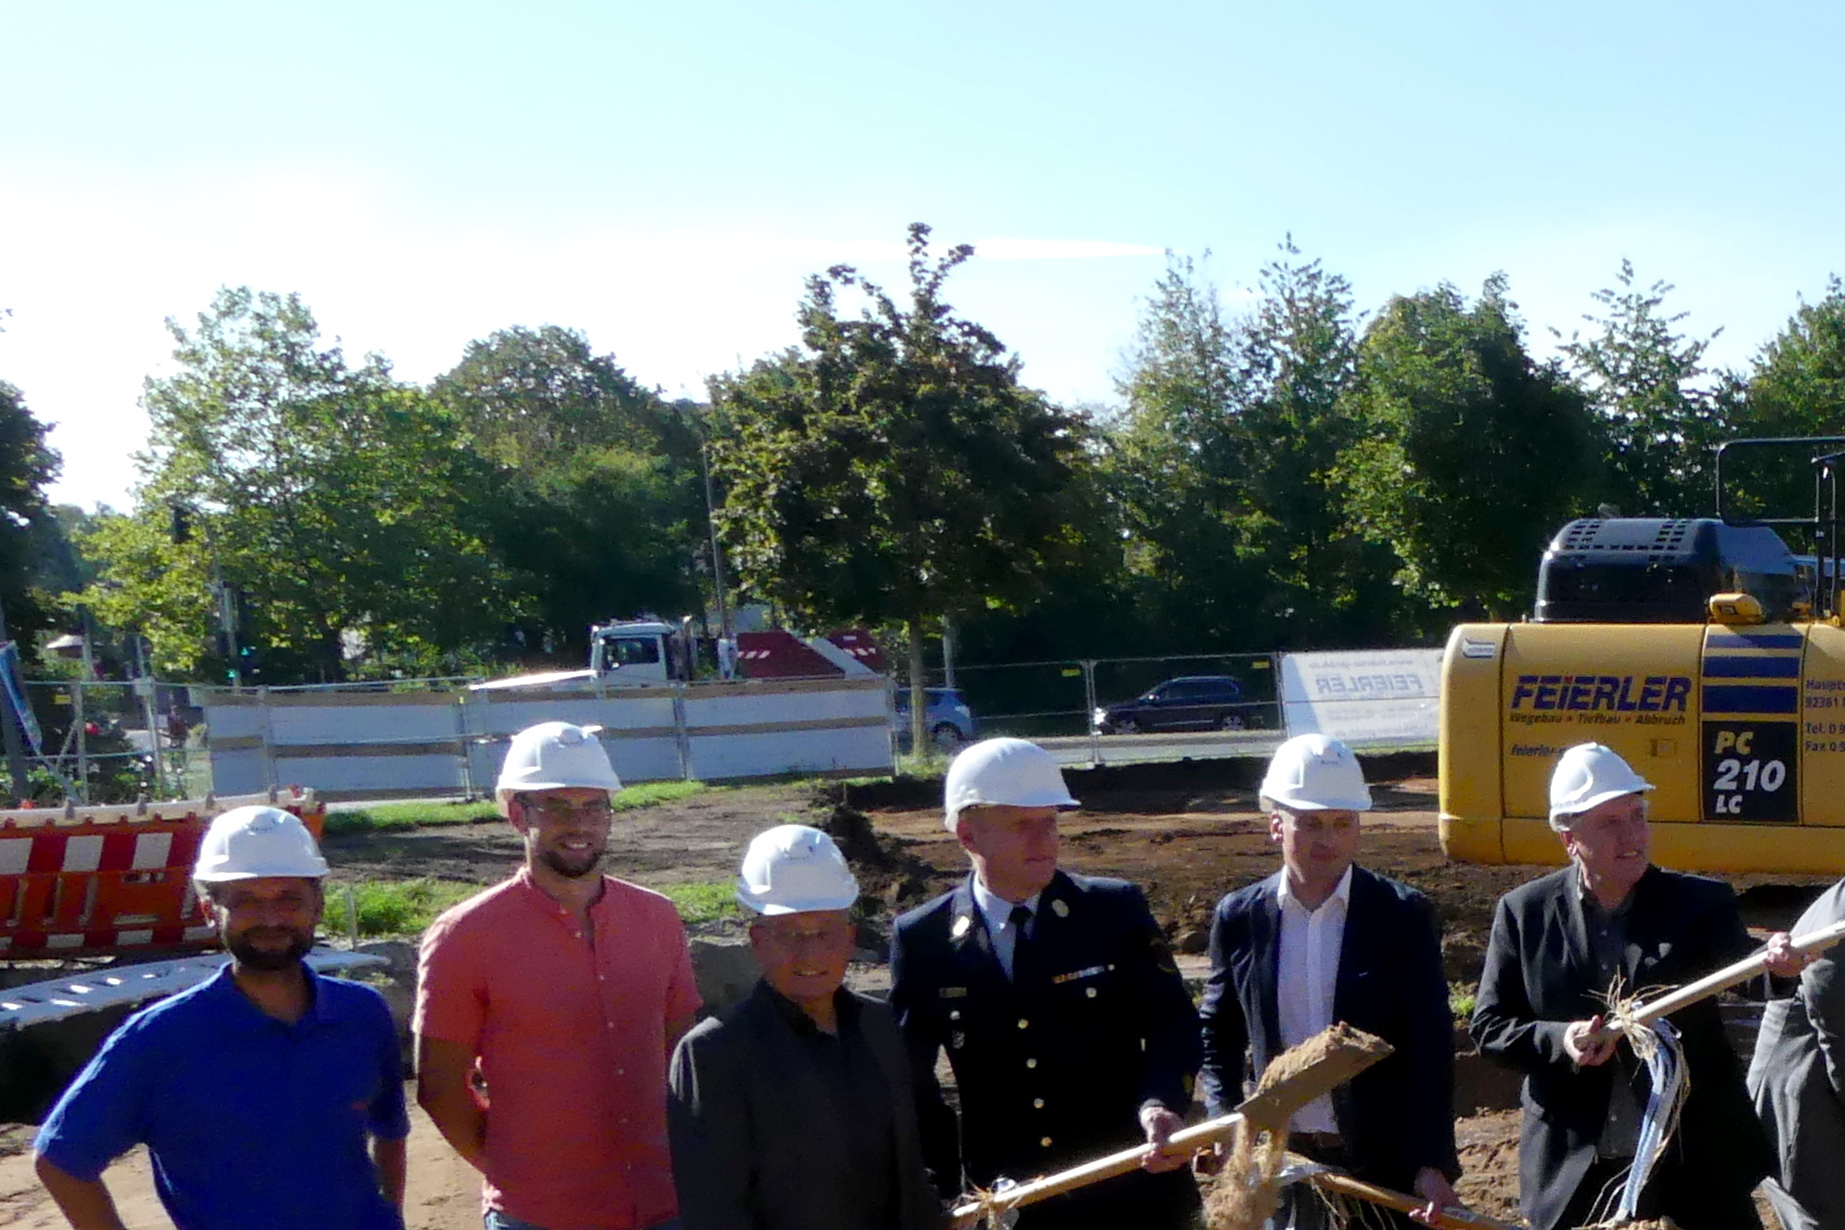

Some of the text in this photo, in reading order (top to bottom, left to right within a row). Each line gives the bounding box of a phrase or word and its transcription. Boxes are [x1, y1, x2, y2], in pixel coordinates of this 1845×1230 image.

[1511, 675, 1692, 712] FEIERLER
[1510, 712, 1686, 726] Wegebau Tiefbau Abbruch
[1805, 723, 1826, 734] Tel.
[1829, 723, 1836, 734] 0
[1714, 730, 1754, 755] PC
[1805, 740, 1826, 752] Fax
[1713, 758, 1786, 792] 210
[1715, 794, 1743, 814] LC
